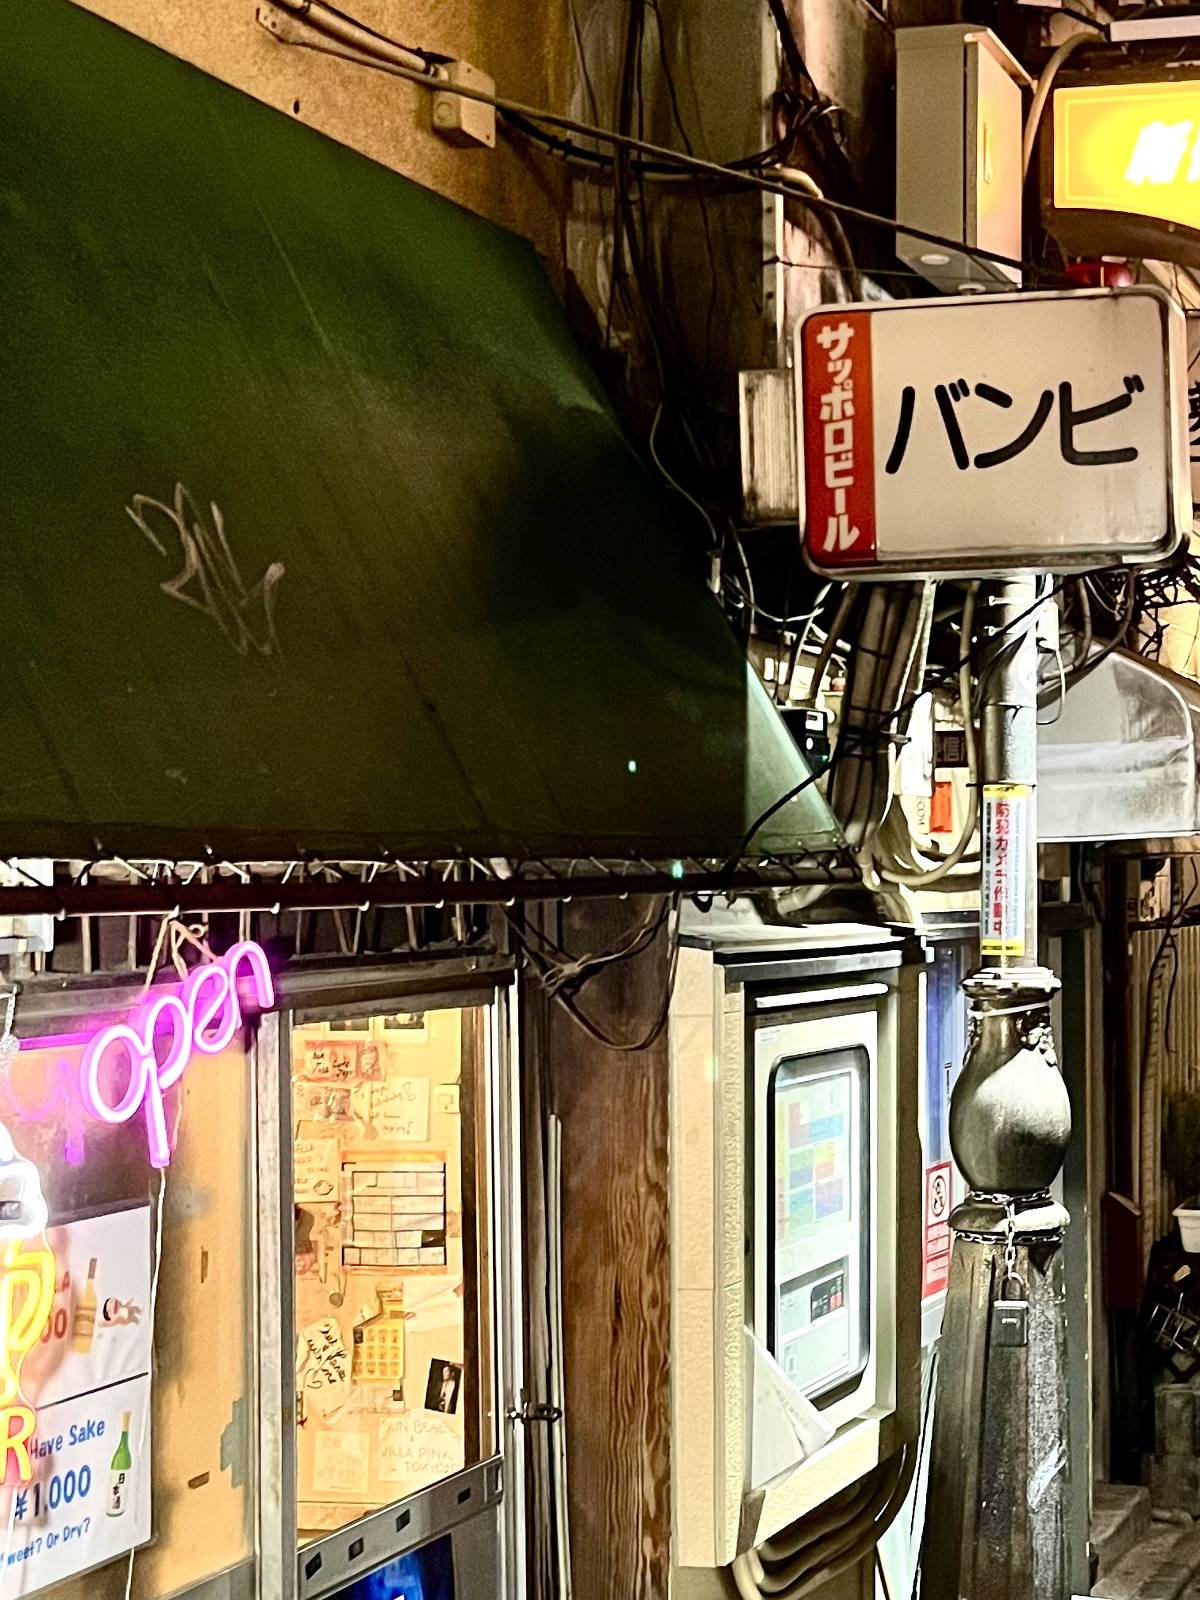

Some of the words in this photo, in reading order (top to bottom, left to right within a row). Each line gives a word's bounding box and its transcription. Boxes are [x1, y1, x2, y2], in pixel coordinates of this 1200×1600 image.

[816, 321, 861, 554] サッポロビール
[885, 374, 1145, 475] バンビ
[81, 939, 275, 1169] open
[69, 1419, 105, 1446] Sake
[0, 1537, 42, 1569] weet?
[47, 1533, 59, 1549] Or
